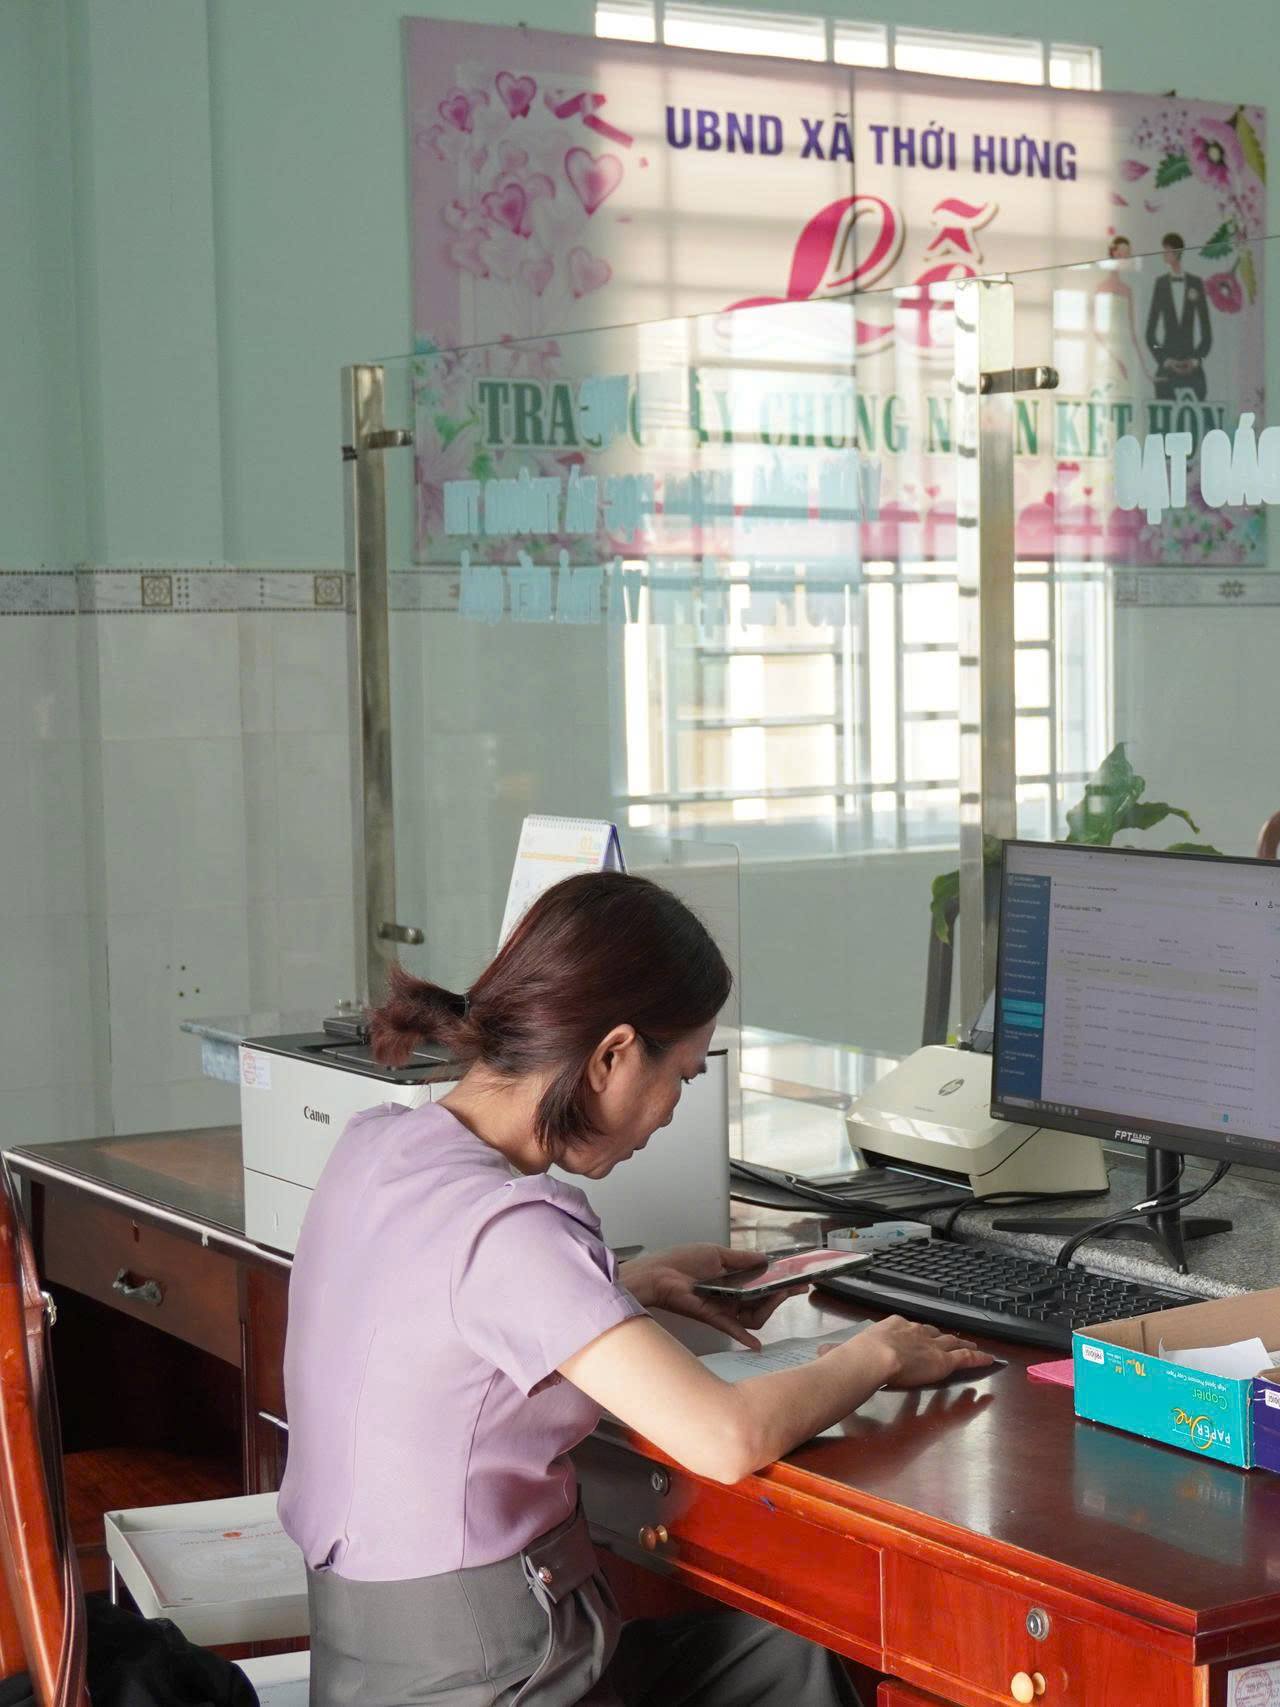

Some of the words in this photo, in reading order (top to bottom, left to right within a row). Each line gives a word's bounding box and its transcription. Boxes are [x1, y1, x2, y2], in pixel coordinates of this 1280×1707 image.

[666, 105, 784, 157] UBND
[800, 111, 855, 164] XÃ
[868, 120, 957, 172] THỚI
[972, 133, 1078, 182] HƯNG
[478, 382, 602, 447] TRA
[303, 1105, 330, 1126] Canon
[1114, 1130, 1132, 1142] FPT
[1191, 1388, 1228, 1411] Copier
